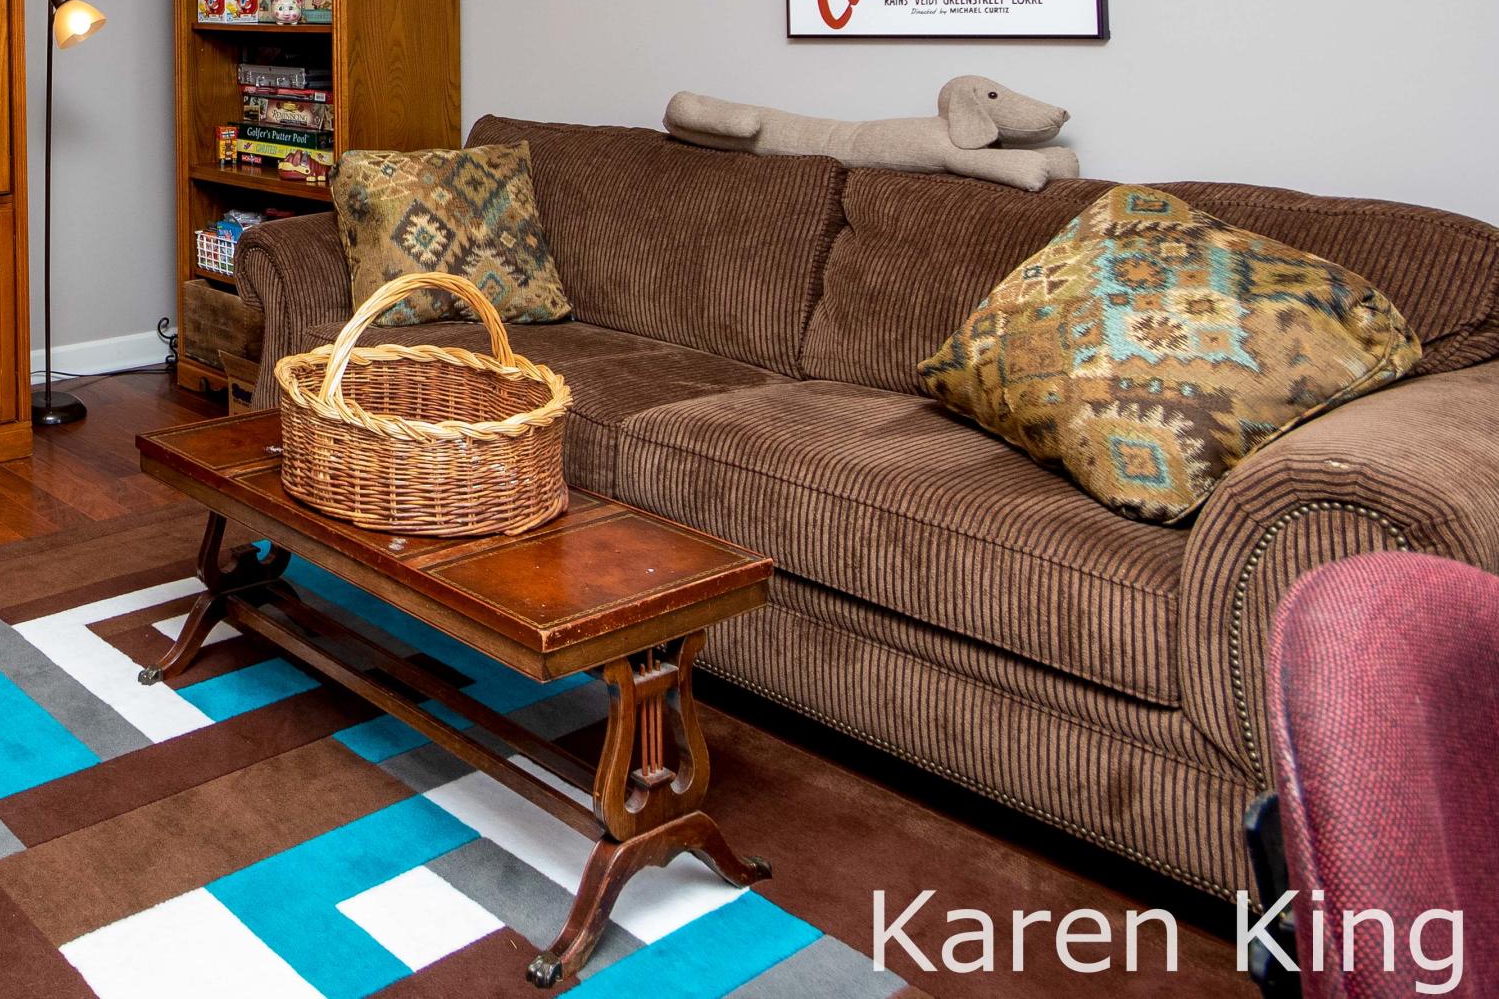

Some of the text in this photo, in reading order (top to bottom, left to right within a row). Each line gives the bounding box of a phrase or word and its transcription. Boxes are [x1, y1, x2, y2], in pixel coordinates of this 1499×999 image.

[984, 6, 1010, 14] CURTIZ
[247, 127, 307, 144] Golfer's Putter Pool
